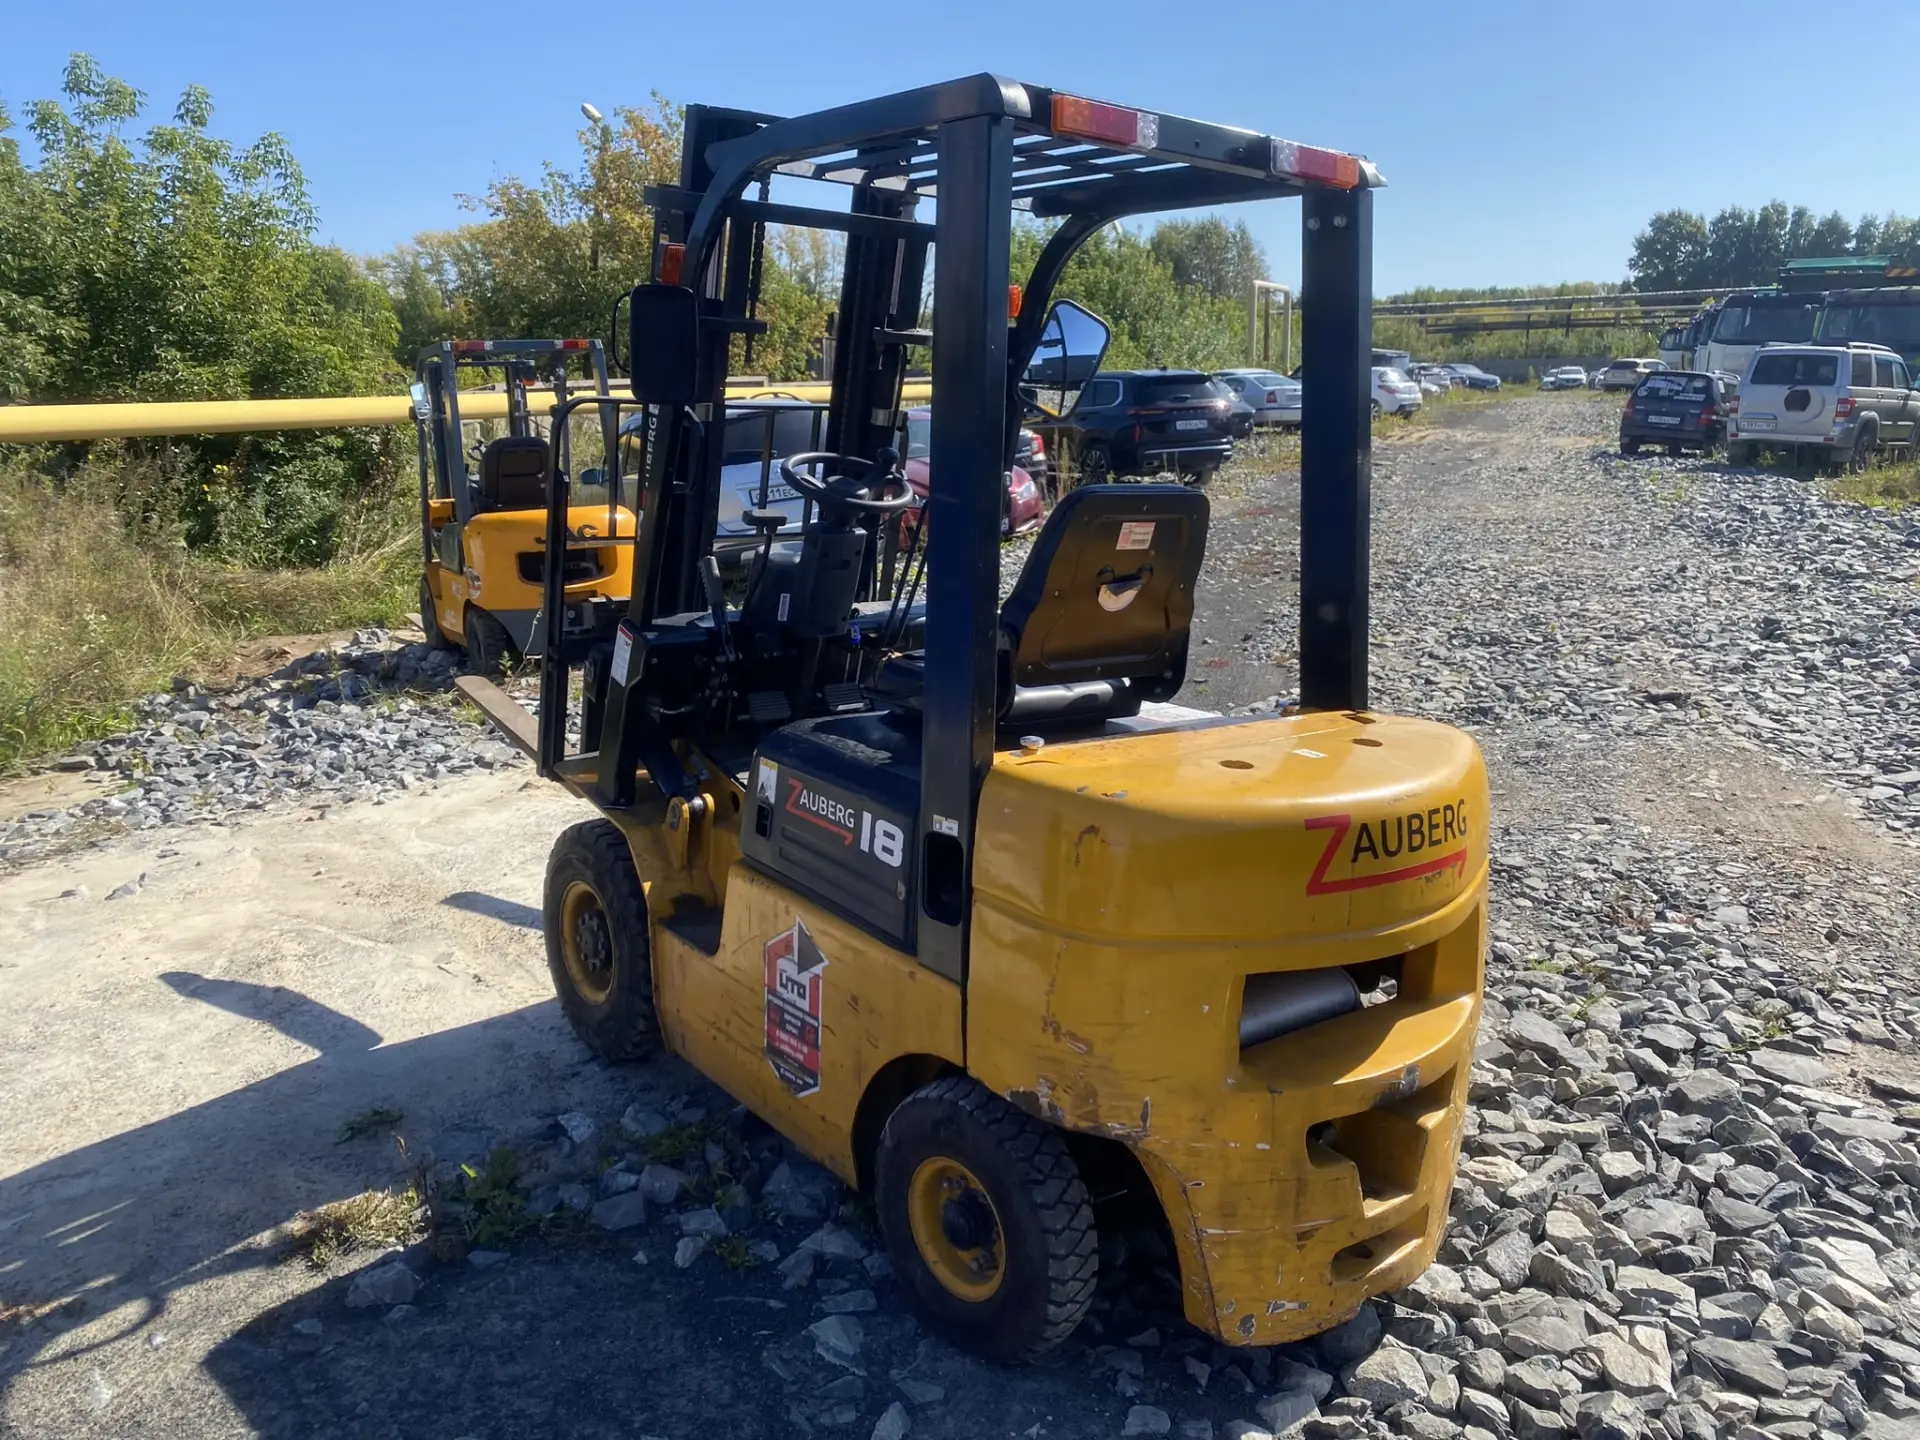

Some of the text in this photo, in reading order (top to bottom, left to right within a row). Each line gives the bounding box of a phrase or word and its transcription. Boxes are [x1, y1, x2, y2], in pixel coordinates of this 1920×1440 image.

[785, 777, 904, 868] ZAUBERG 18
[1304, 799, 1467, 897] ZAUBERG
